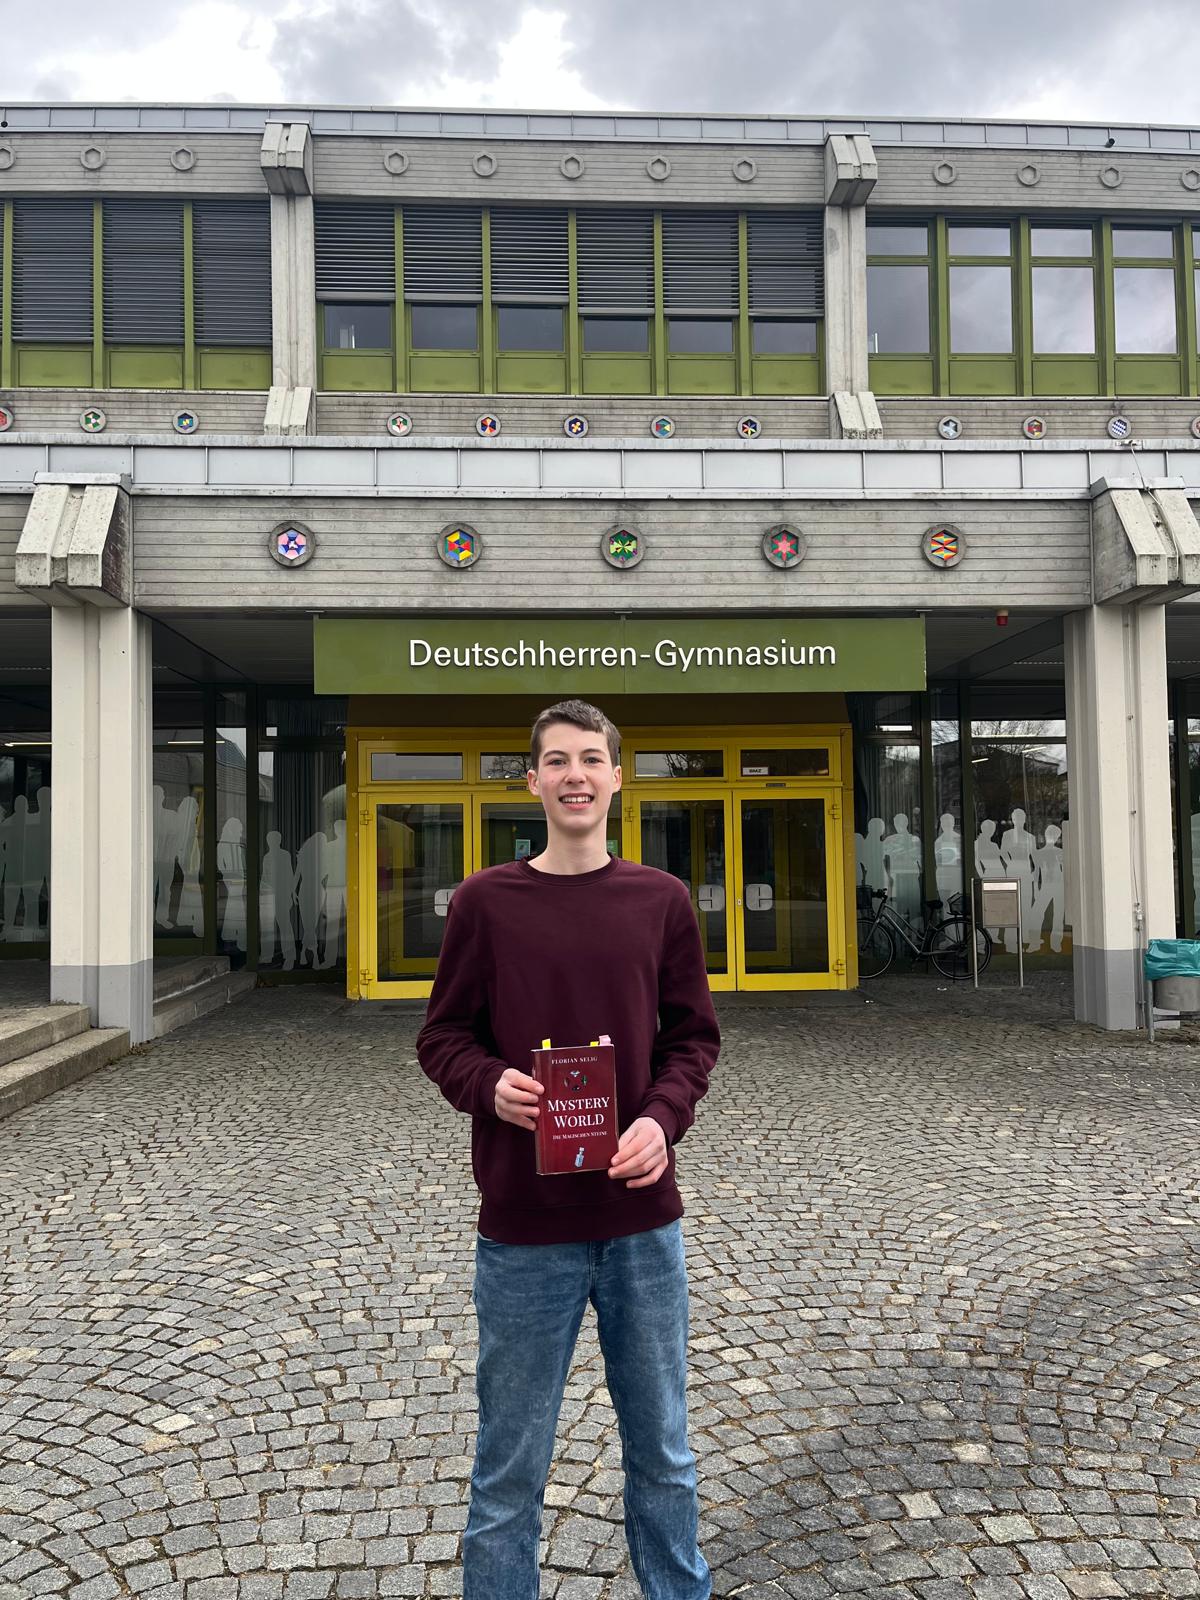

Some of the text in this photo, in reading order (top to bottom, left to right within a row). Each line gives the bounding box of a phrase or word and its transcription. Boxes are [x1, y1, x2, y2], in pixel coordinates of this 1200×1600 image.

[409, 638, 836, 672] Deutschherren-Gymnasium
[551, 1057, 578, 1065] FLORIAN
[547, 1097, 610, 1112] MYSTERY
[553, 1113, 605, 1129] WORLD
